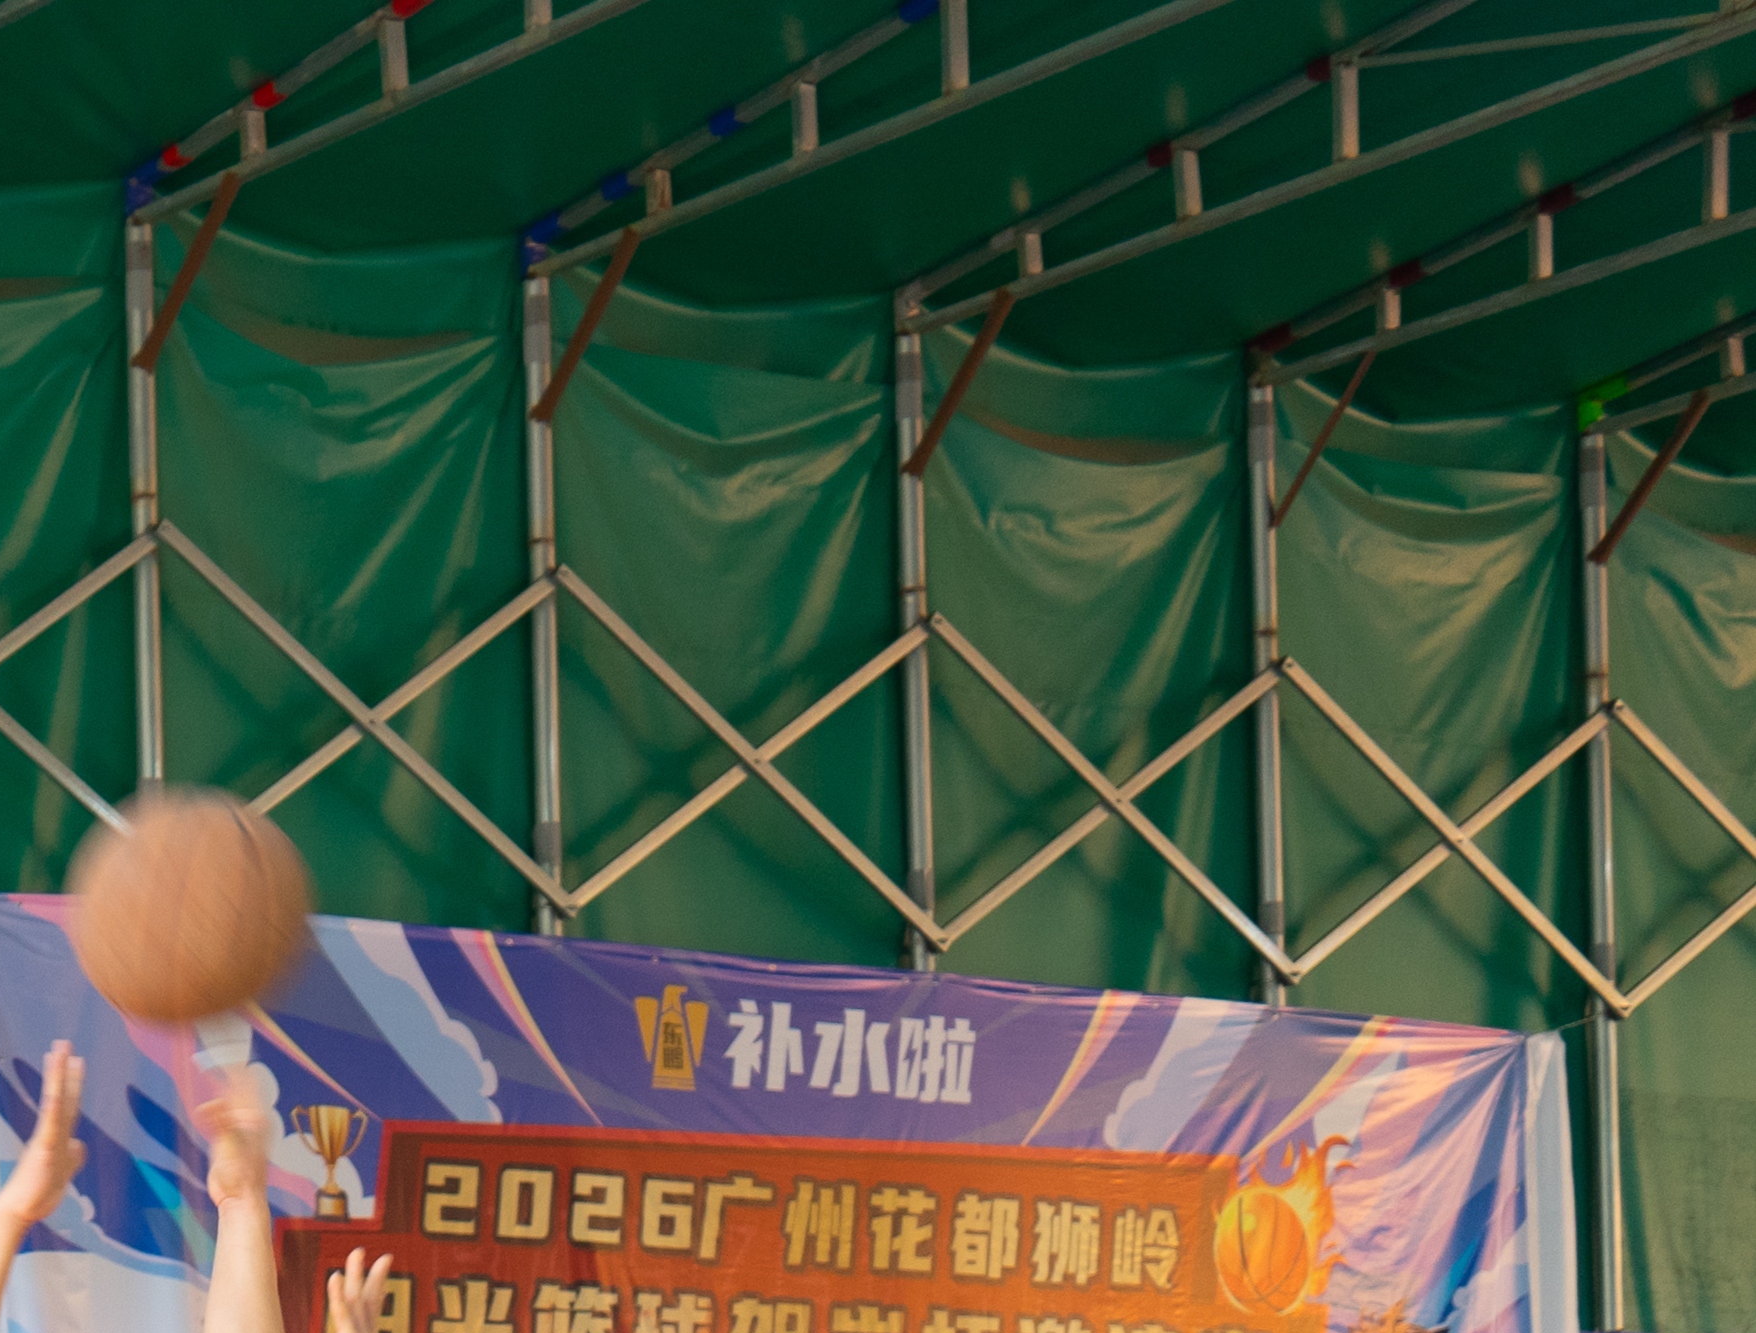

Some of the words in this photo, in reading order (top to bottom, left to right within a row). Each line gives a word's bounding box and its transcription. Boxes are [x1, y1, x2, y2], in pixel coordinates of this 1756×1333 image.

[724, 999, 976, 1104] 补水啦
[422, 1162, 1183, 1292] 2026广州花都狮岭
